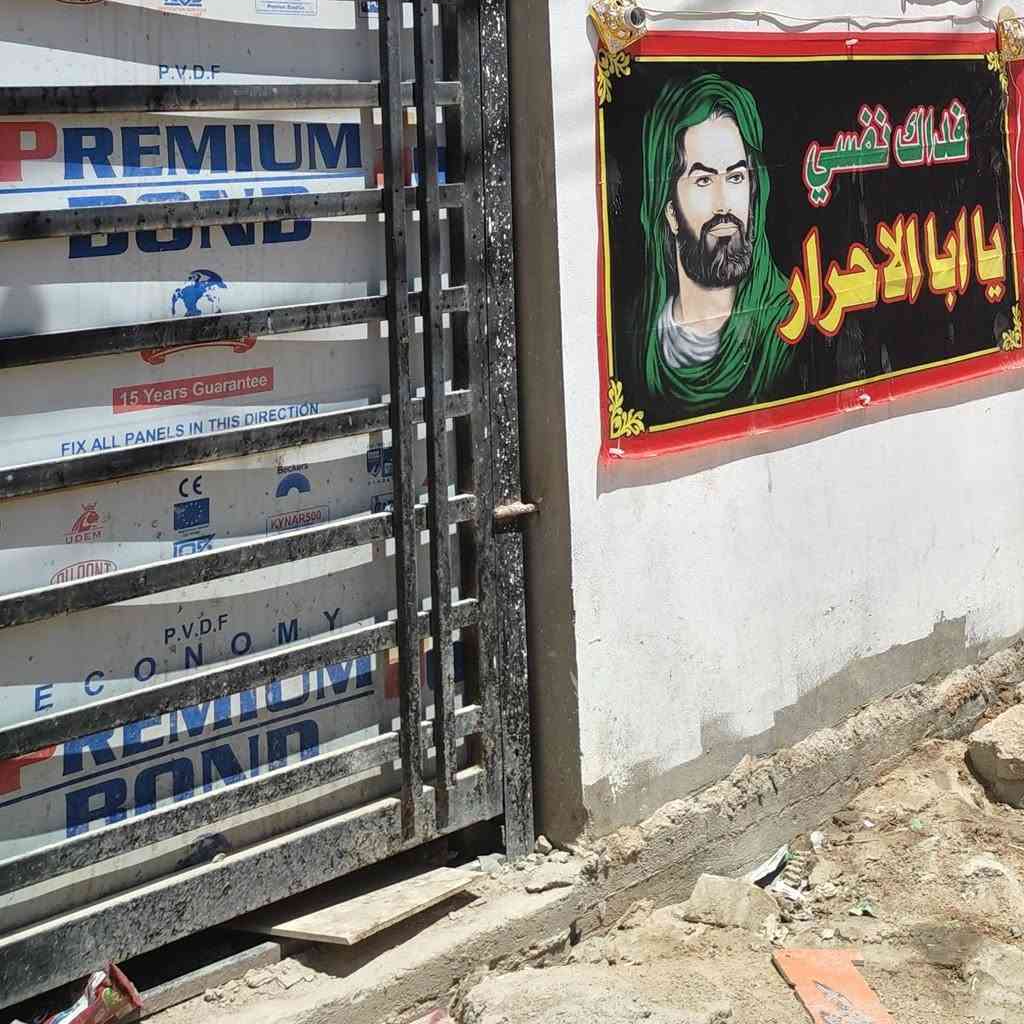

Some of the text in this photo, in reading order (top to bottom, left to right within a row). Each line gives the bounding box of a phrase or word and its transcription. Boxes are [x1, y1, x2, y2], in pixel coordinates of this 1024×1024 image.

[159, 64, 221, 80] P.V.D.F
[0, 121, 363, 182] PREMIUM
[803, 97, 971, 207] فداك نفسي
[68, 186, 312, 259] BOND
[776, 206, 1006, 346] يا ابا الاحرار
[119, 373, 269, 408] 15 Years Guarantee
[61, 402, 319, 457] FIX ALL PANELS IN THIS DIRECTION
[178, 475, 202, 497] CE
[65, 531, 103, 544] UDEM
[163, 614, 229, 644] P.V.D.F
[34, 607, 342, 713] ECONOMY
